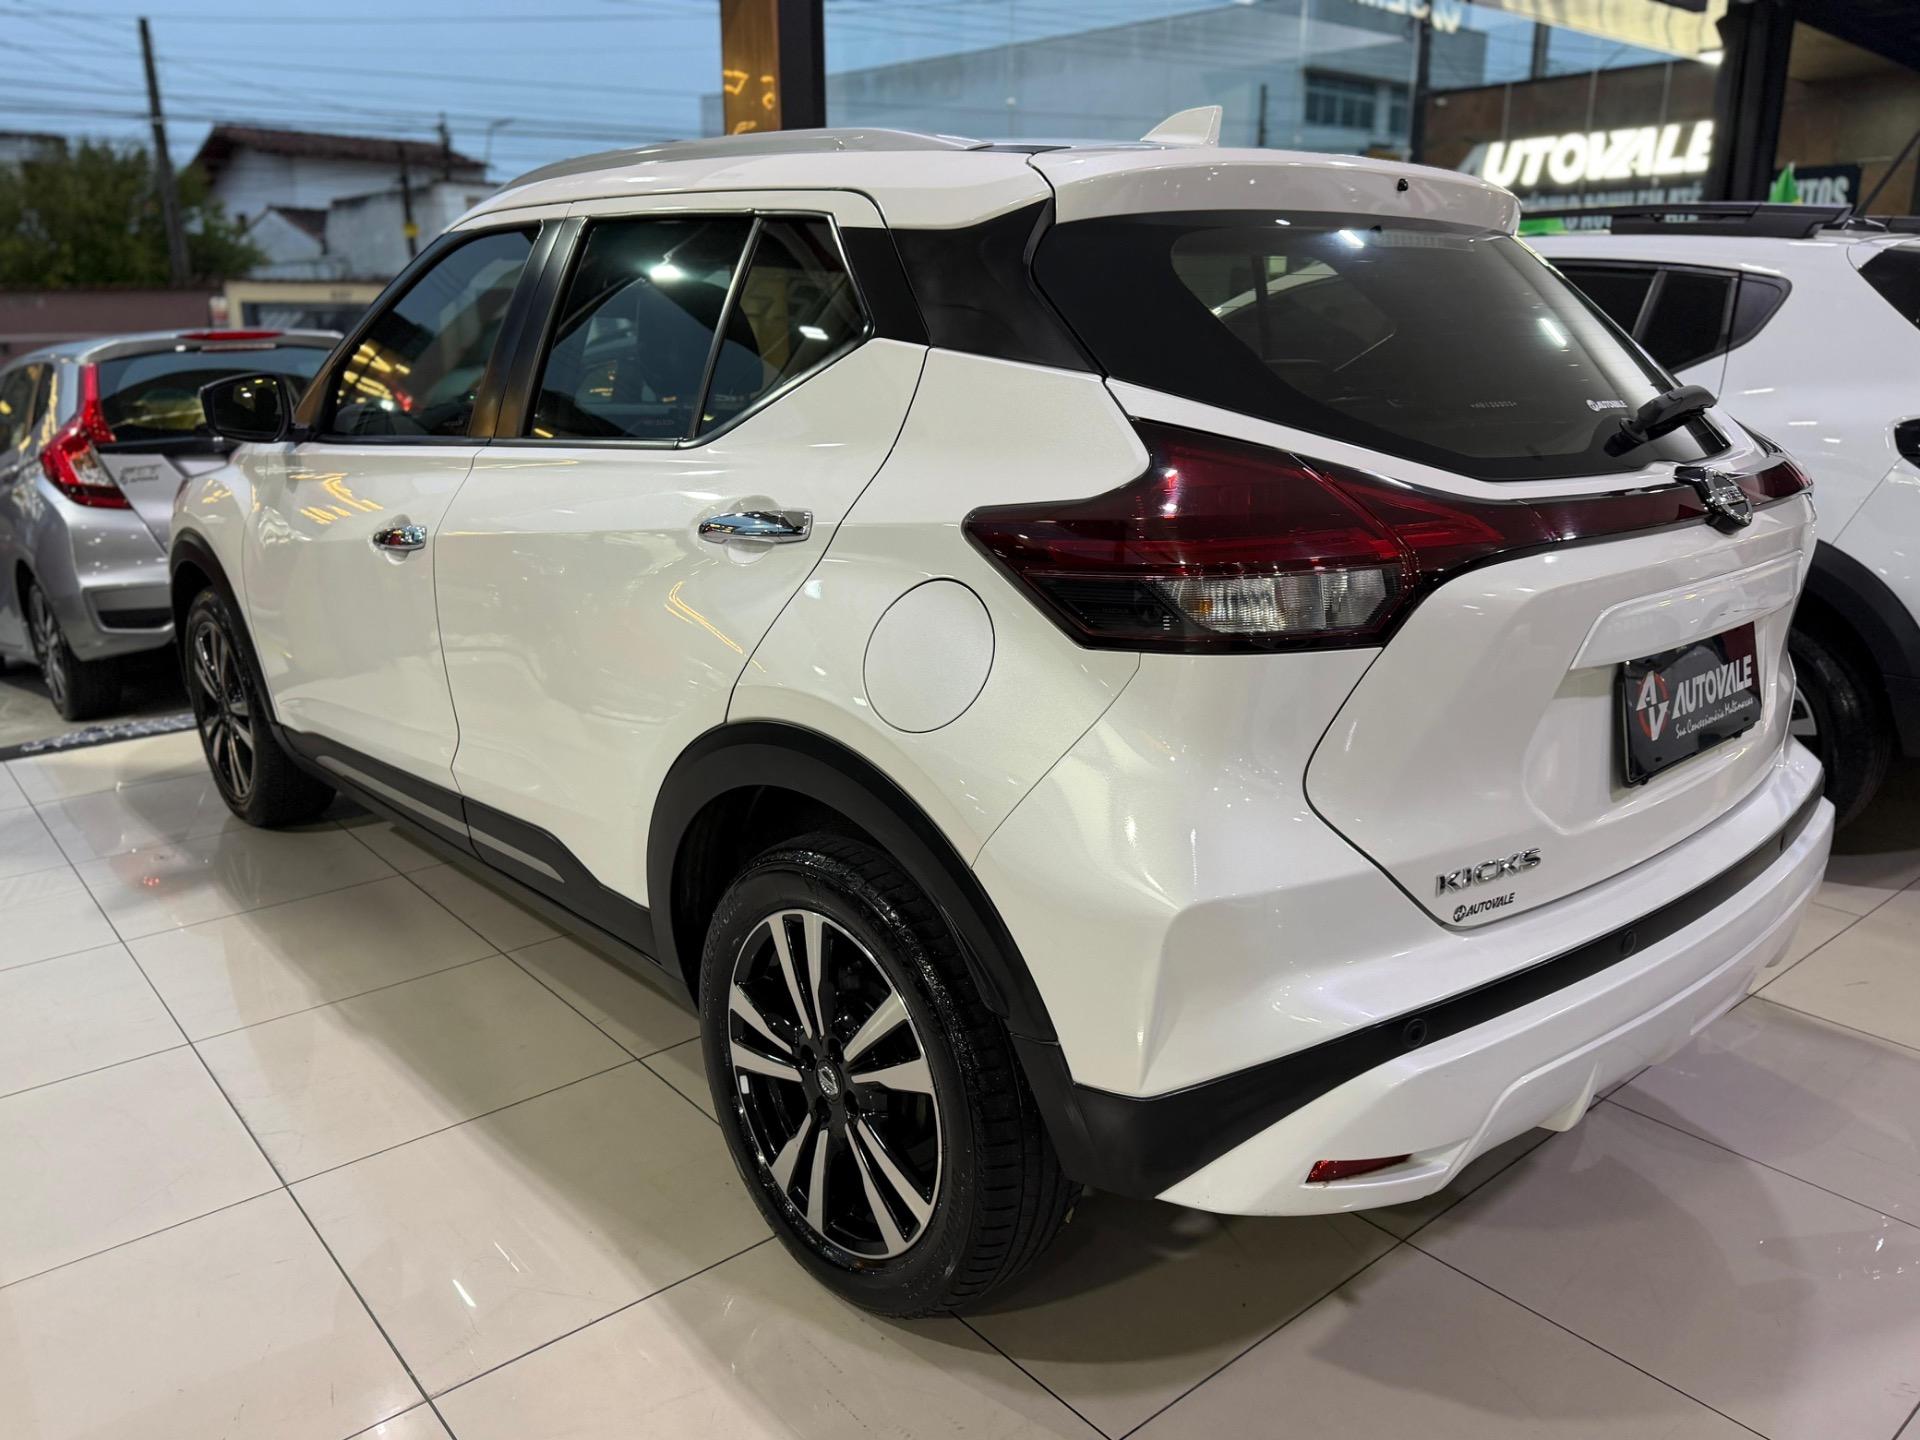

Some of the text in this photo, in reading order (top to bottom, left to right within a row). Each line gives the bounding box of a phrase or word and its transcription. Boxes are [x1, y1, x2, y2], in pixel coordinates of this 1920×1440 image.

[1458, 119, 1715, 187] AUTOVALE
[1672, 654, 1753, 720] AUTOVALE
[1435, 848, 1541, 898] KICKS
[1466, 892, 1516, 917] AUTOVALE
